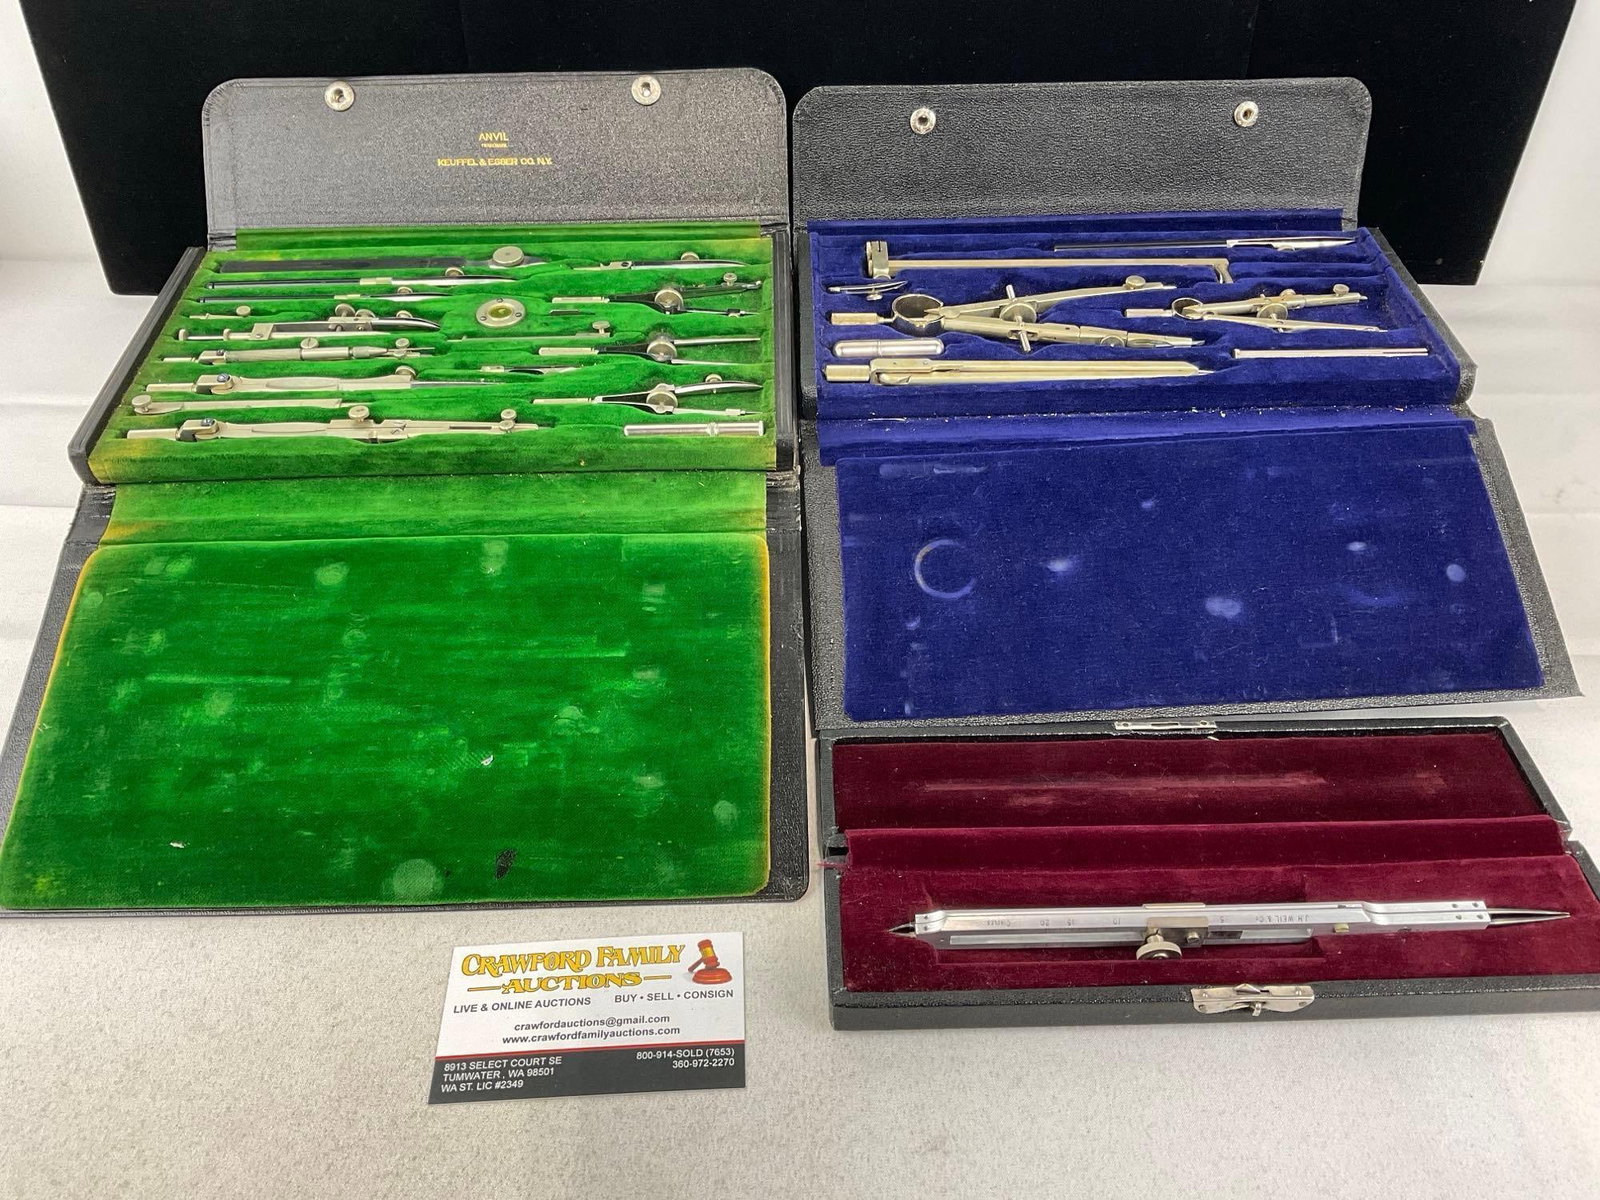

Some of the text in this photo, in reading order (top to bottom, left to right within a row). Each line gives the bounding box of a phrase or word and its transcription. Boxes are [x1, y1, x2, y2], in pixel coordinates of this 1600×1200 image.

[478, 132, 509, 141] ANVIL
[438, 158, 478, 166] KEUFFEL
[479, 158, 487, 166] &
[520, 157, 535, 165] CO.
[461, 944, 686, 978] CRAWFORD FAMILY
[501, 972, 643, 994] AUCTIONS
[614, 989, 734, 1003] BUY SELL CONSIGN
[453, 996, 592, 1014] LIVE & ONLINE AUCTIONS
[514, 1015, 671, 1031] crawfordauctions@gmail.com
[502, 1026, 681, 1044] www.crawfordfamilyauctions.com
[636, 1047, 735, 1060] 800-914-SOLD (7653)
[444, 1056, 563, 1072] 8913 SELECT COURT SE
[672, 1058, 735, 1069] 360-972-2270
[508, 1068, 526, 1078] WA
[527, 1067, 555, 1077] 98501
[441, 1079, 524, 1093] WA ST. LIC #2349
